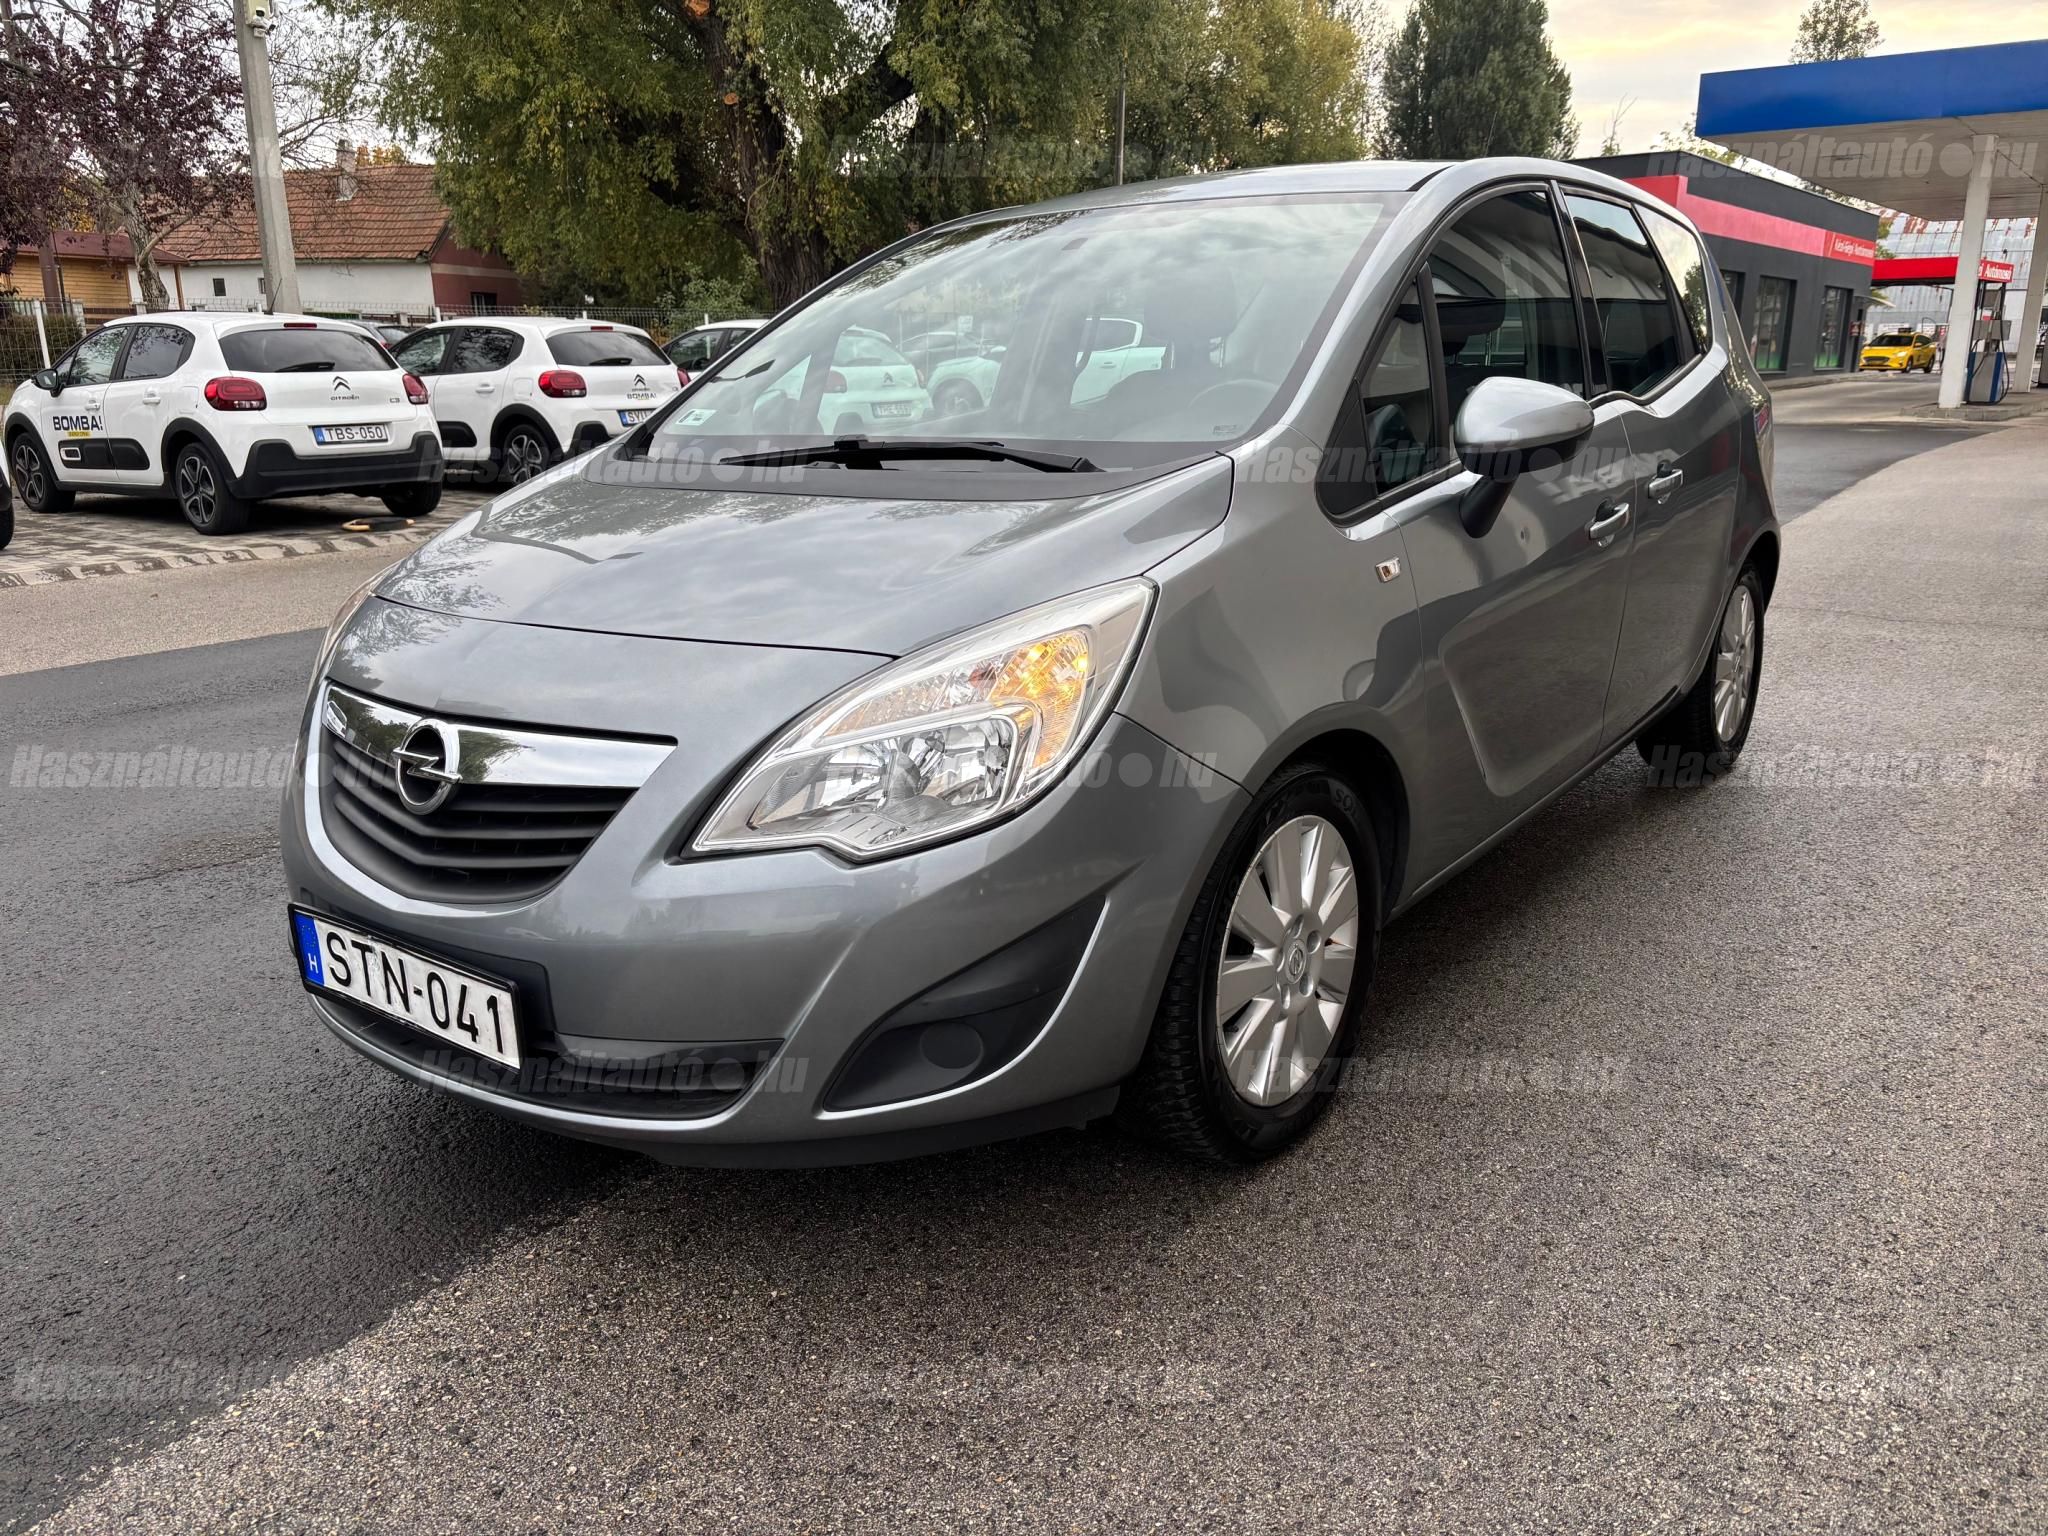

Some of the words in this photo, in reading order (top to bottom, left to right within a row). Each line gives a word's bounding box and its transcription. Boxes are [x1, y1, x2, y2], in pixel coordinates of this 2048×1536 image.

[52, 415, 103, 431] BOMBA!
[325, 426, 383, 441] TBS-050
[307, 952, 319, 974] H
[326, 931, 504, 1054] STN-041
